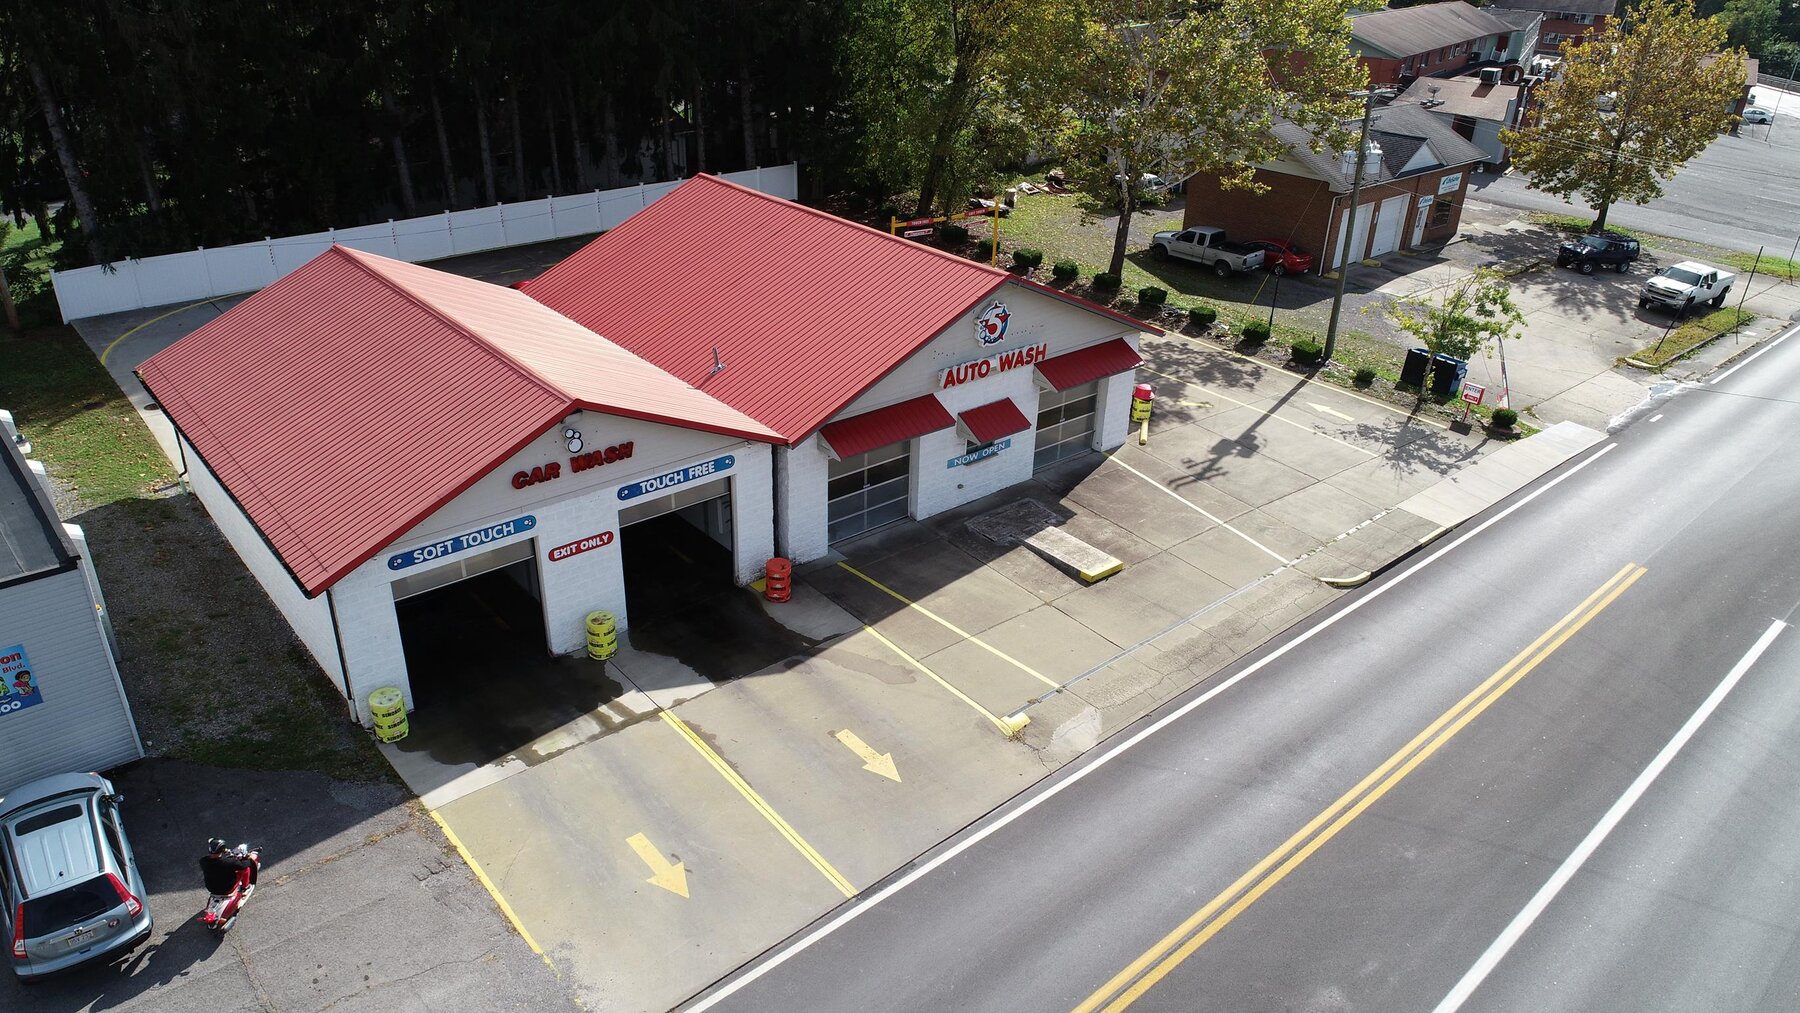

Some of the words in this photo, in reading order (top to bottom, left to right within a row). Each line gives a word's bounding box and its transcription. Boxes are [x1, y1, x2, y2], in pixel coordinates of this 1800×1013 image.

[943, 359, 991, 389] AUTO
[999, 344, 1047, 373] WASH
[1465, 384, 1480, 393] ENTER
[512, 462, 561, 489] CAR
[570, 441, 634, 473] WASH
[954, 452, 979, 466] NOW
[982, 442, 1006, 457] OPEN
[639, 471, 684, 494] TOUCH
[688, 461, 715, 480] FREE
[413, 540, 454, 563] SOFT
[460, 522, 515, 549] TOUCH
[553, 544, 578, 559] EXIT
[580, 533, 610, 551] ONLY
[2, 663, 26, 674] Blvd.
